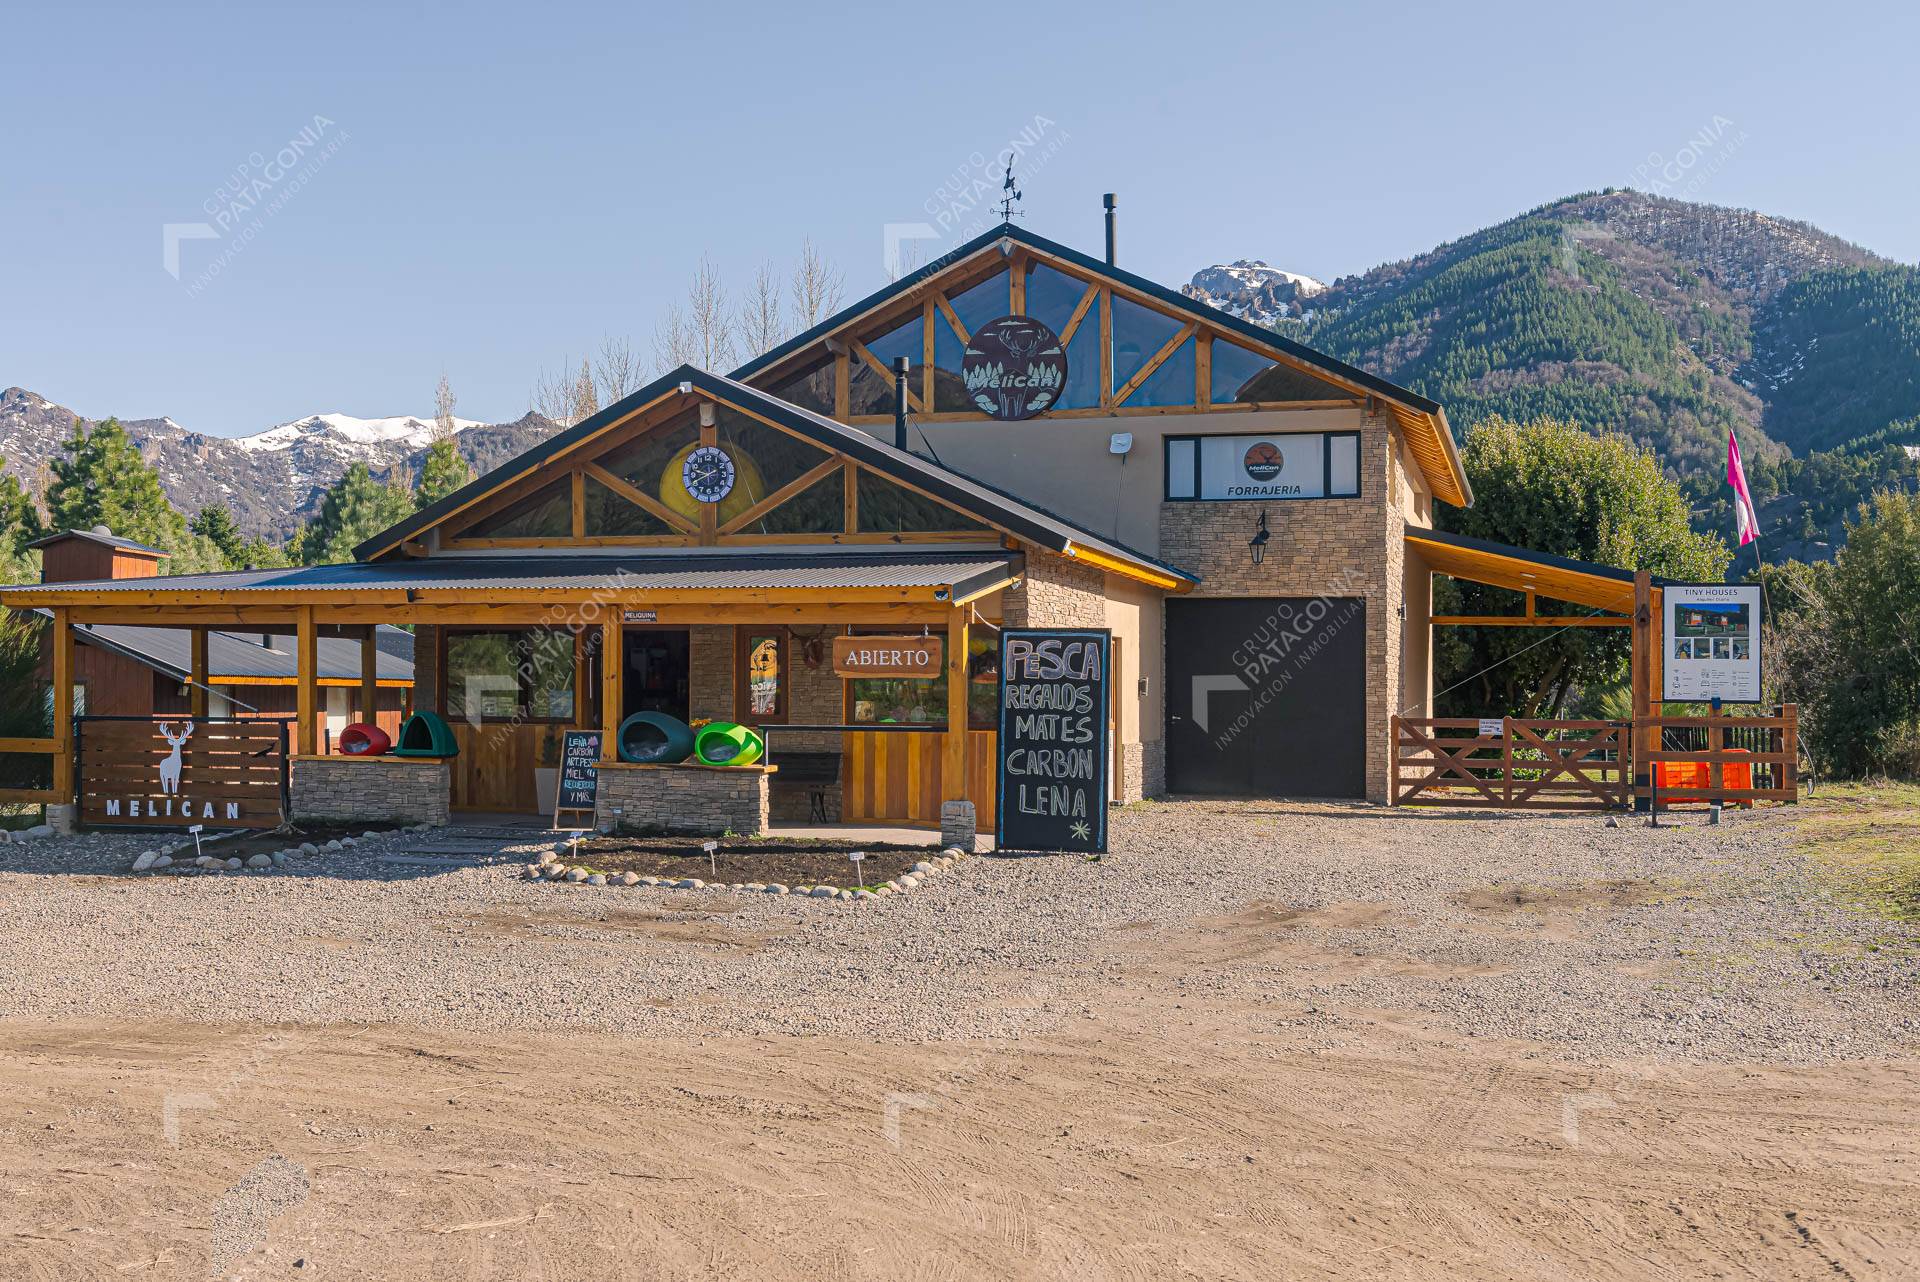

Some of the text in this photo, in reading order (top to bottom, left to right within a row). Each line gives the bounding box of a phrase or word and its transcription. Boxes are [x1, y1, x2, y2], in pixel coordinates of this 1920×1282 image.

[1227, 485, 1301, 496] FORRAJERIA
[846, 650, 929, 666] ABIERTO
[1006, 640, 1100, 681] PESCA
[1005, 682, 1093, 713] REGALOS
[1015, 714, 1093, 744] MATES
[1007, 748, 1093, 779] CARBON
[106, 799, 238, 819] MELICAN
